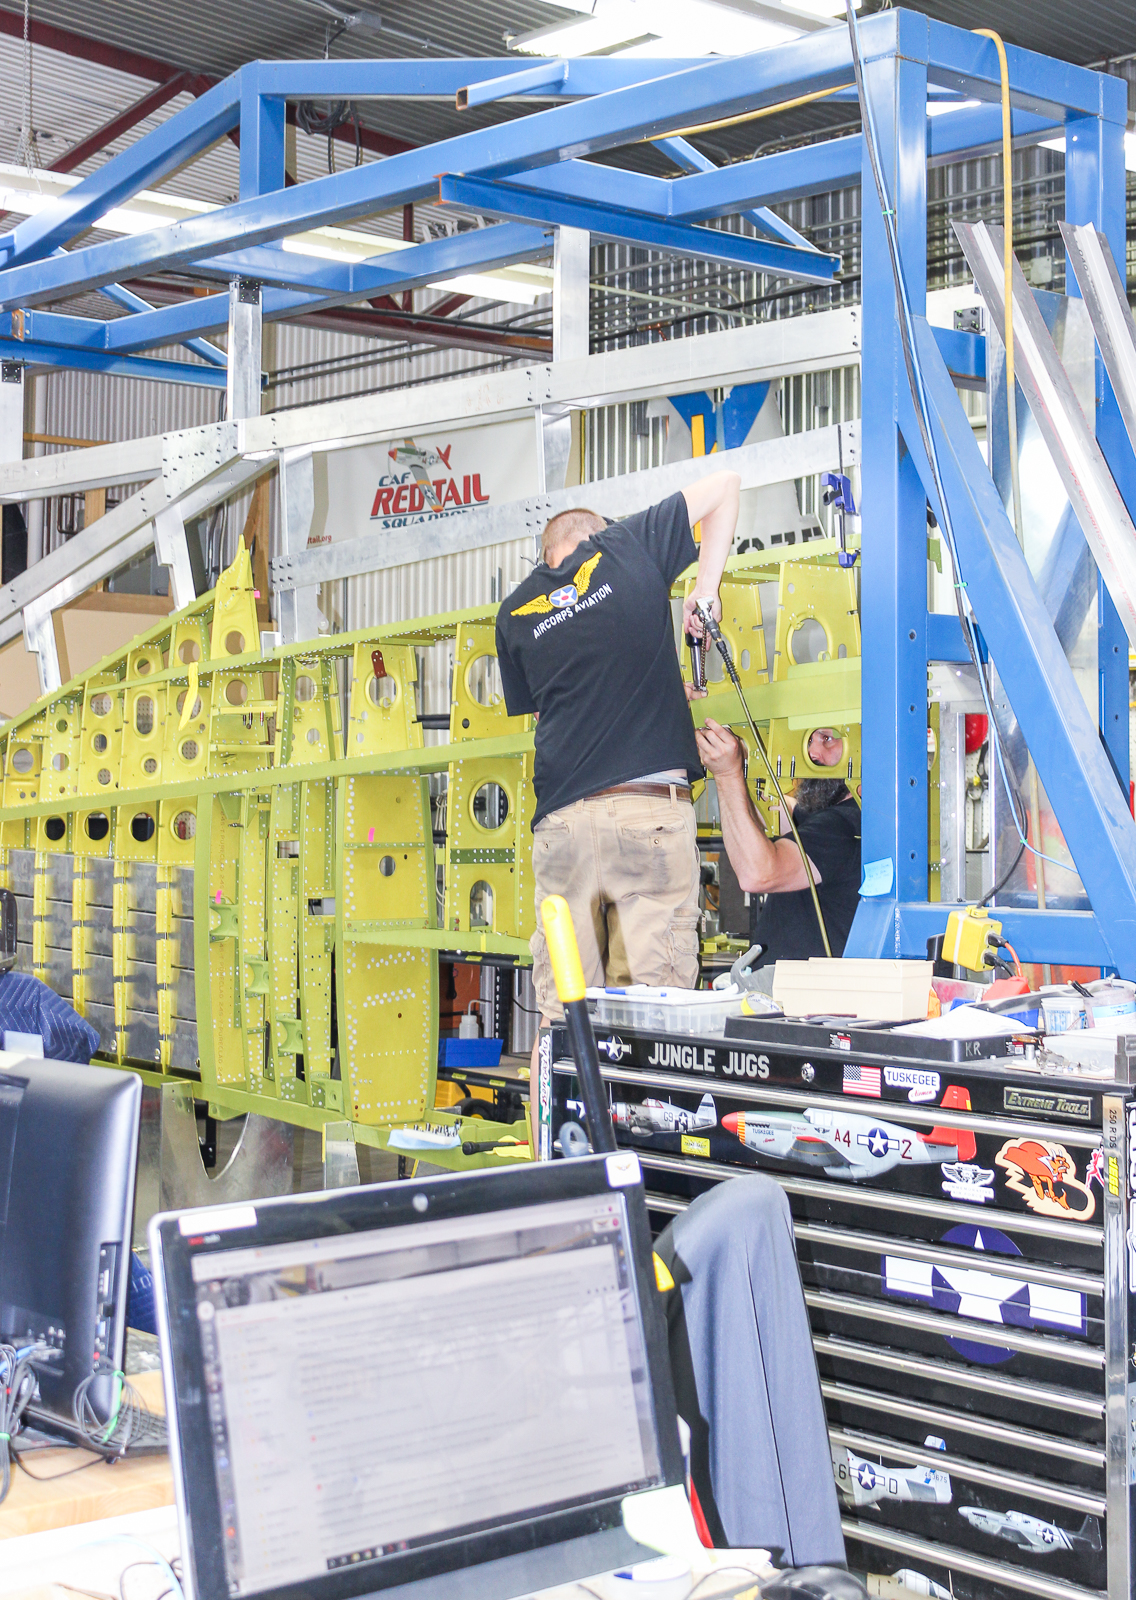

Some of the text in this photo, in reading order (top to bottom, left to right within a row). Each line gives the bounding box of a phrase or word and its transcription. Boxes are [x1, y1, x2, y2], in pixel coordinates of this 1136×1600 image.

[379, 472, 411, 487] CAF
[371, 473, 490, 516] RED TAIL
[381, 508, 474, 530] SQUAD
[533, 583, 613, 640] AIRCORPS AVIATION
[965, 1041, 982, 1057] KR
[648, 1042, 770, 1079] JUNGLE JUGS
[887, 1070, 937, 1087] TUSKEGEE
[1007, 1092, 1055, 1110] EXTREME
[663, 1111, 674, 1122] G9
[1109, 1110, 1117, 1125] 250
[834, 1128, 851, 1148] A4
[901, 1139, 913, 1160] 2
[1109, 1156, 1119, 1197] JEGS
[888, 1477, 898, 1495] D
